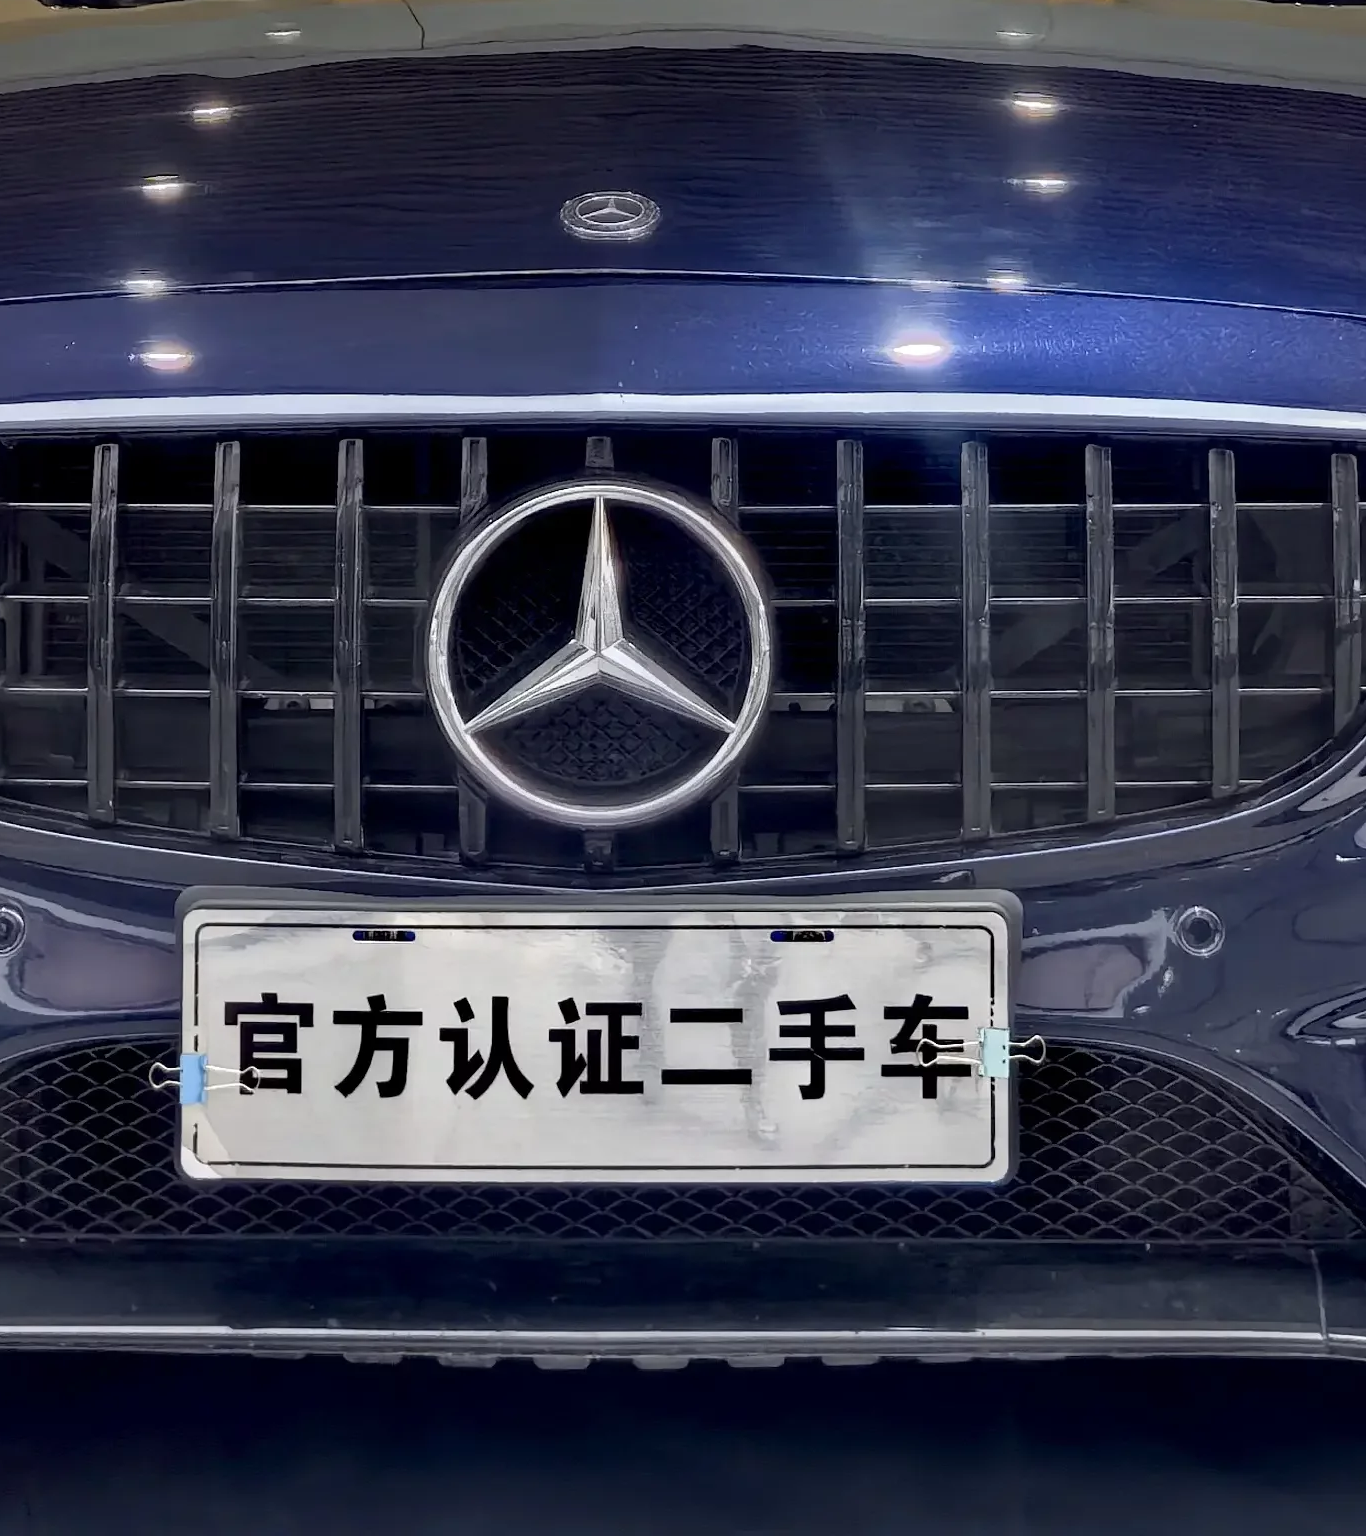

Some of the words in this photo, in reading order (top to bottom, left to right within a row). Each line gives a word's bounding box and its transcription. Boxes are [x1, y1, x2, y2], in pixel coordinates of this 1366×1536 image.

[224, 993, 972, 1100] 官方认证二手车
